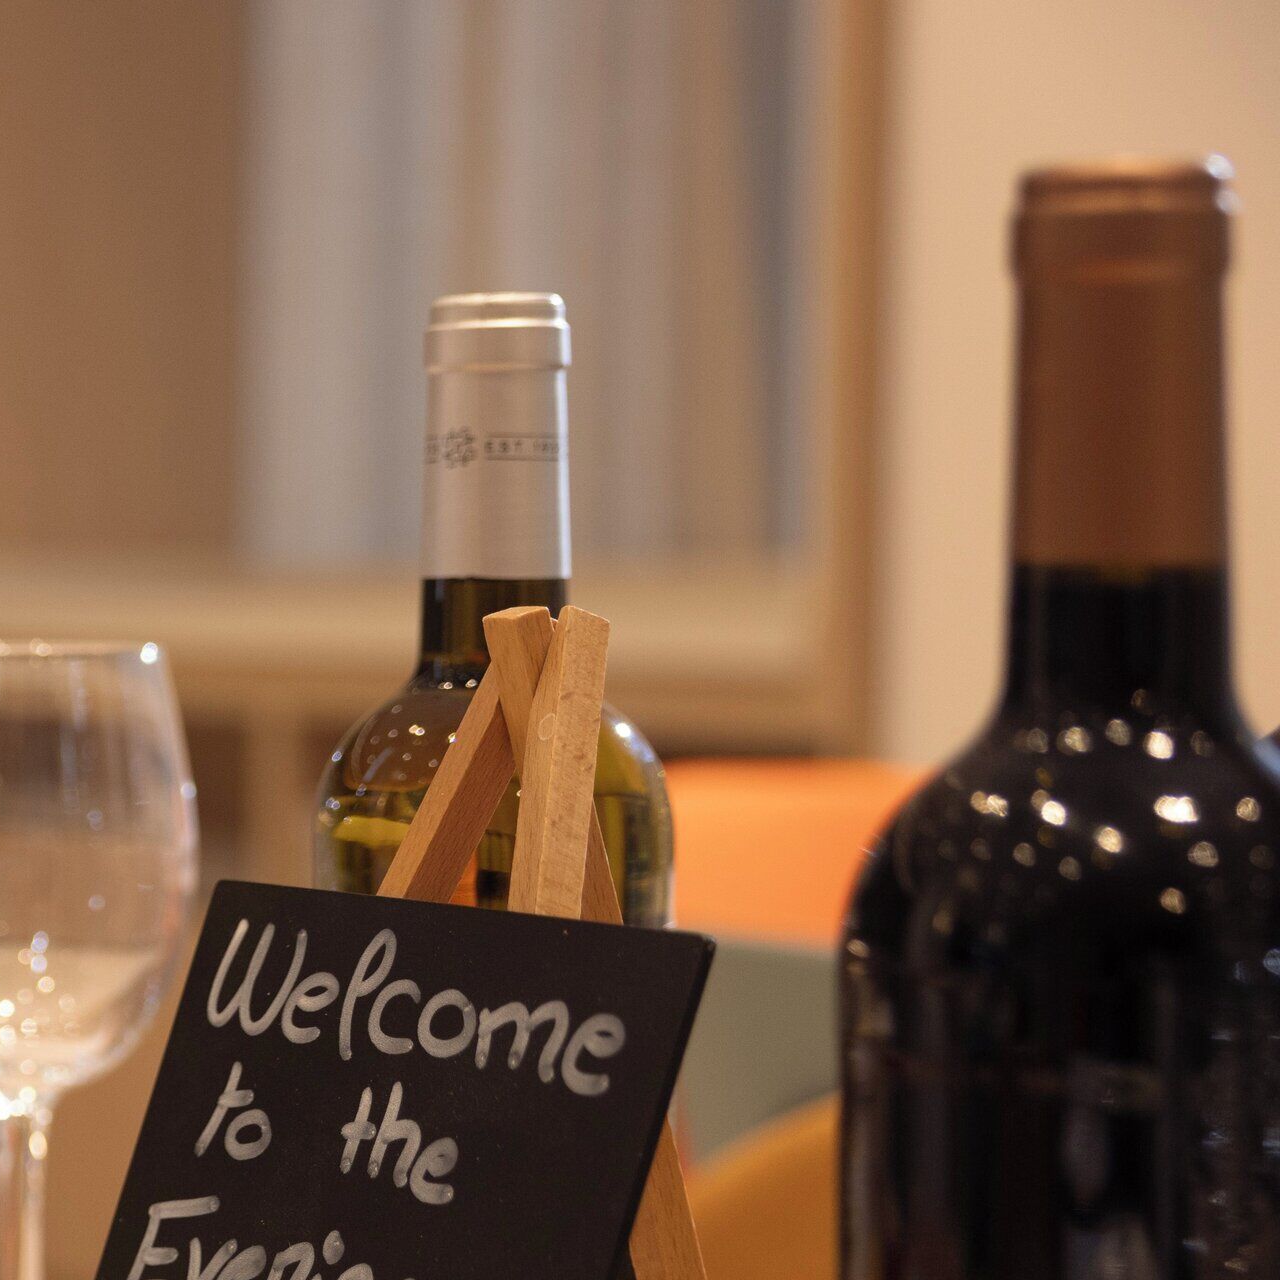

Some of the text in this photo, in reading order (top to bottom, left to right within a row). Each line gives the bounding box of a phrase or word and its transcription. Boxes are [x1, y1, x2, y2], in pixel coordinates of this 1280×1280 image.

[207, 919, 627, 1096] Welcome
[195, 1062, 459, 1204] to the
